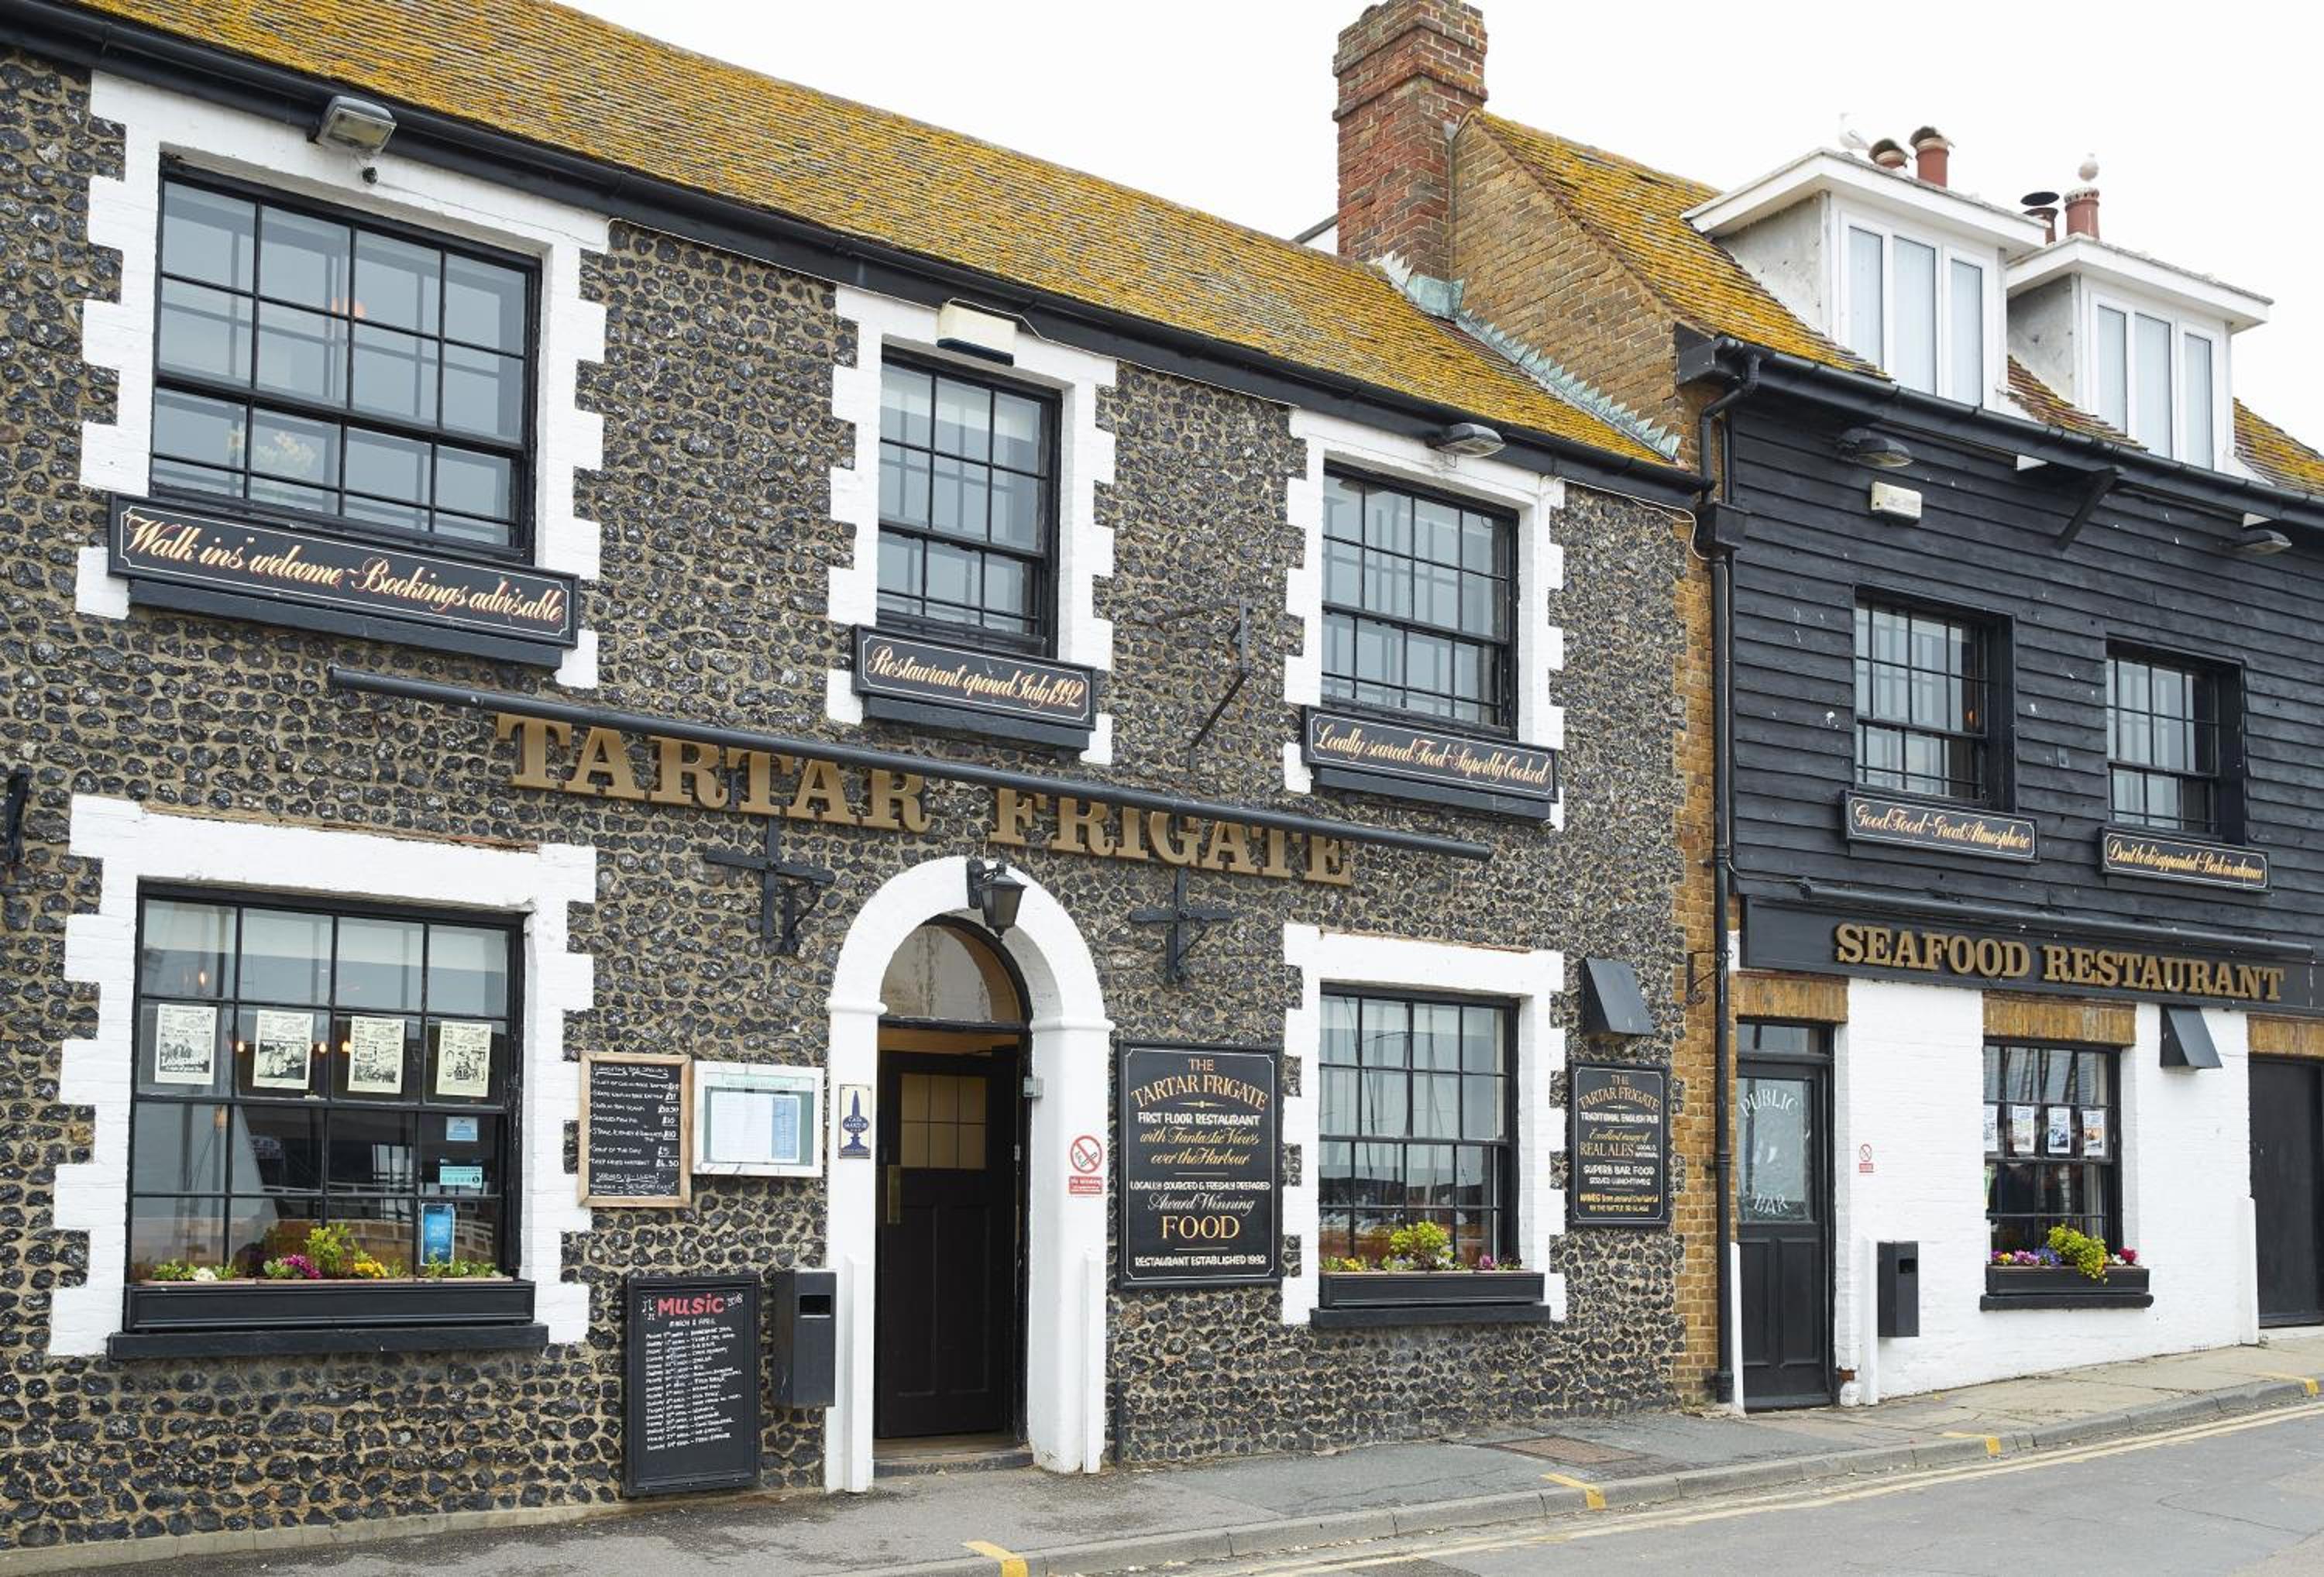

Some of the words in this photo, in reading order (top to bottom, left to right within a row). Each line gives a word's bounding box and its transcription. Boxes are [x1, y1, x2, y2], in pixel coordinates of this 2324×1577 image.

[248, 545, 346, 586] welcome
[469, 576, 565, 622] advisable
[867, 645, 967, 689] Restaurant
[963, 670, 1020, 696] opened
[1013, 673, 1049, 709] July
[1047, 678, 1085, 708] 1992
[1315, 721, 1366, 761] Locally
[1364, 737, 1415, 762] sourced
[1411, 739, 1451, 768] Food
[1502, 755, 1550, 785] Cooked
[496, 713, 931, 833] TARTAR
[988, 786, 1353, 886] FRIGATE
[1854, 802, 1893, 830] Good
[1889, 808, 1929, 834] Food
[1930, 815, 1968, 840] Great
[1960, 820, 2031, 850] Atmosphere
[1834, 922, 2030, 978] SEAFOOD
[2043, 944, 2284, 1002] RESTAURANT
[1188, 1058, 1215, 1071] THE
[1611, 1074, 1629, 1085] THE
[1130, 1074, 1200, 1108] TARTAR
[1203, 1074, 1269, 1111] FRIGATE
[1578, 1087, 1618, 1110] TARTAR
[1618, 1085, 1660, 1114] FRIGATE
[1739, 1087, 1799, 1118] PUBLIC
[1137, 1111, 1162, 1124] FIRST
[1164, 1112, 1193, 1124] FLOOR
[1195, 1113, 1262, 1125] RESTAURANT
[1140, 1127, 1167, 1143] with
[1167, 1127, 1224, 1144] Fantastic
[1223, 1128, 1261, 1145] Views
[1151, 1152, 1177, 1165] over
[1177, 1147, 1197, 1164] the
[1194, 1147, 1252, 1166] Harbour
[1580, 1141, 1606, 1156] REAL
[1607, 1142, 1635, 1156] ALES
[1583, 1164, 1613, 1175] SUPERB
[1614, 1165, 1631, 1175] BAR
[1632, 1166, 1655, 1176] FOOD
[1129, 1181, 1162, 1190] LOCALLY
[1163, 1181, 1198, 1190] SOURCED
[1205, 1181, 1236, 1190] FRESHLY
[1236, 1181, 1271, 1190] PREPARED
[1147, 1192, 1198, 1211] Award
[1198, 1192, 1256, 1217] Winning
[1753, 1191, 1789, 1215] BAR
[1161, 1215, 1240, 1239] FOOD
[1134, 1256, 1189, 1267] RESTAURANT
[1191, 1255, 1246, 1266] ESTABLISHED
